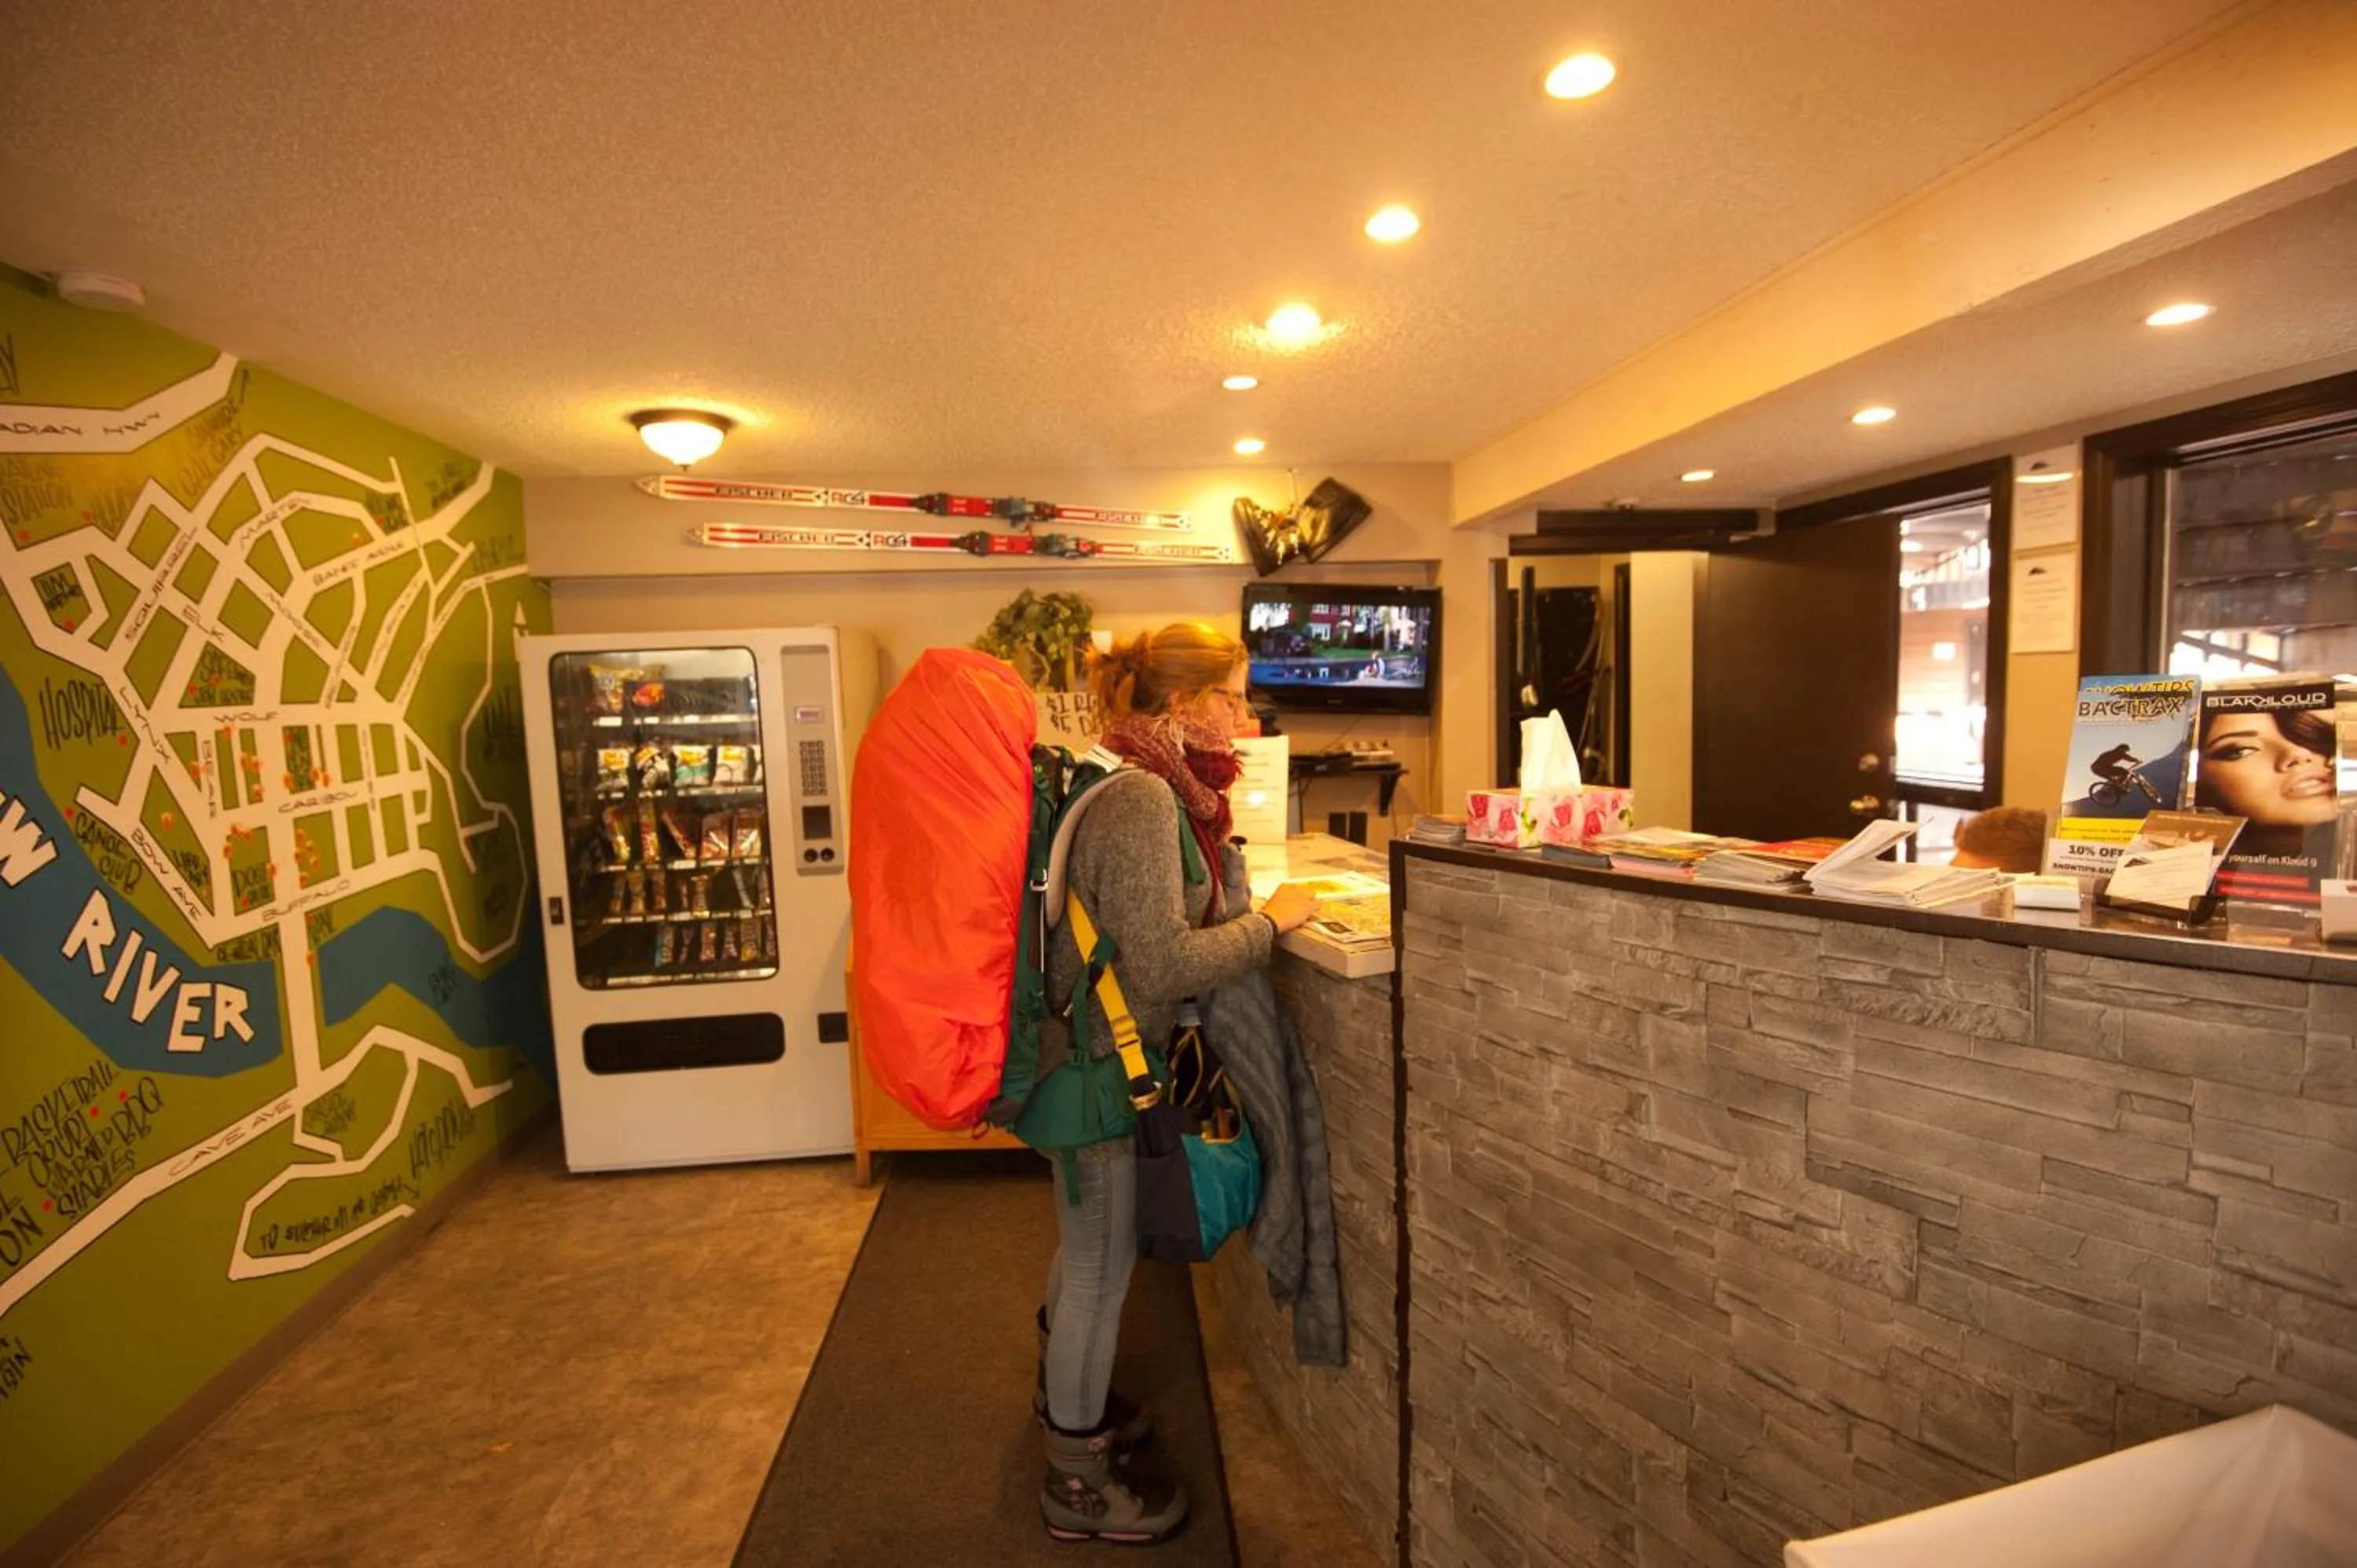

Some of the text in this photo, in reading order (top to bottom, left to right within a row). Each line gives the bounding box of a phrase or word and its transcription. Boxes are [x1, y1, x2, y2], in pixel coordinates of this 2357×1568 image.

[181, 604, 225, 643] ELK
[119, 685, 172, 765] LYNX
[213, 711, 279, 724] WOLF
[277, 790, 358, 814] CARIBOU
[130, 826, 171, 875] BOW
[172, 885, 203, 923] AVE
[262, 878, 351, 922] BUFFALO
[60, 887, 255, 1053] RIVER
[167, 1124, 247, 1177] CAVE
[252, 1099, 293, 1127] AVE
